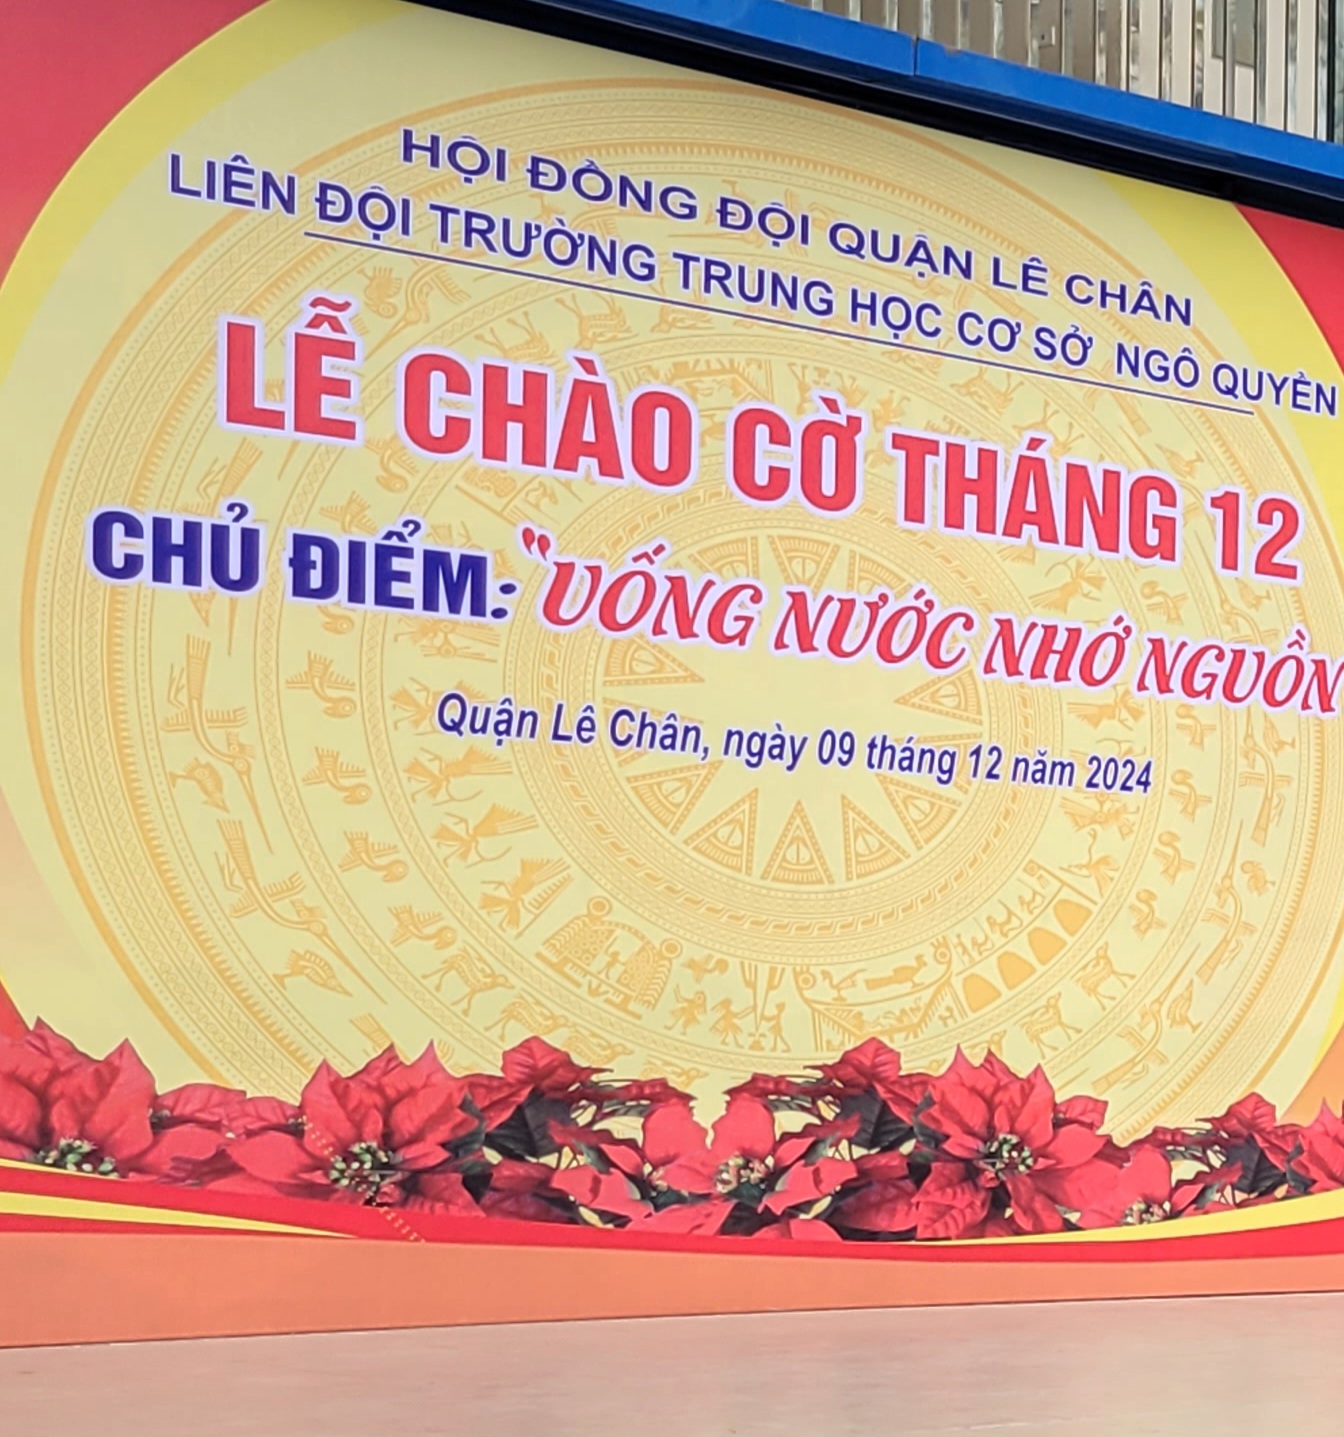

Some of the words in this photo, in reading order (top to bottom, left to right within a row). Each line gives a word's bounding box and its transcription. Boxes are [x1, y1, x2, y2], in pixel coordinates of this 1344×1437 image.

[170, 153, 297, 215] LIÊN
[314, 181, 412, 241] ĐỘI
[429, 203, 656, 283] TRƯỜNG
[672, 251, 834, 317] TRUNG
[850, 287, 943, 340] HỌC
[957, 311, 1022, 353] CƠ
[1033, 324, 1094, 367] SỞ
[1116, 342, 1201, 388] NGÔ
[1212, 363, 1337, 416] QUYỀN
[402, 128, 507, 184] HỘI
[525, 155, 698, 221] ĐỒNG
[715, 196, 810, 248] ĐỘI
[828, 222, 973, 280] QUẬN
[992, 256, 1049, 297] LÊ
[1065, 274, 1192, 327] CHÂN
[225, 296, 358, 440] LỄ
[403, 352, 694, 489] CHÀO
[732, 396, 864, 513] CỜ
[890, 432, 1178, 563] THÁNG
[1209, 490, 1300, 580] 12
[91, 501, 260, 593] CHỦ
[288, 519, 517, 620] ĐIỂM:
[772, 589, 975, 670] NƯỚC
[983, 615, 1133, 688] NHỚ
[436, 692, 540, 748] Quận
[550, 703, 597, 745] Lê
[609, 708, 710, 762] Chân,
[722, 722, 810, 773] ngày
[817, 729, 856, 768] 09
[866, 734, 958, 786] tháng
[968, 744, 1004, 781] 12
[1010, 749, 1077, 788] năm
[1084, 755, 1154, 794] 2024
